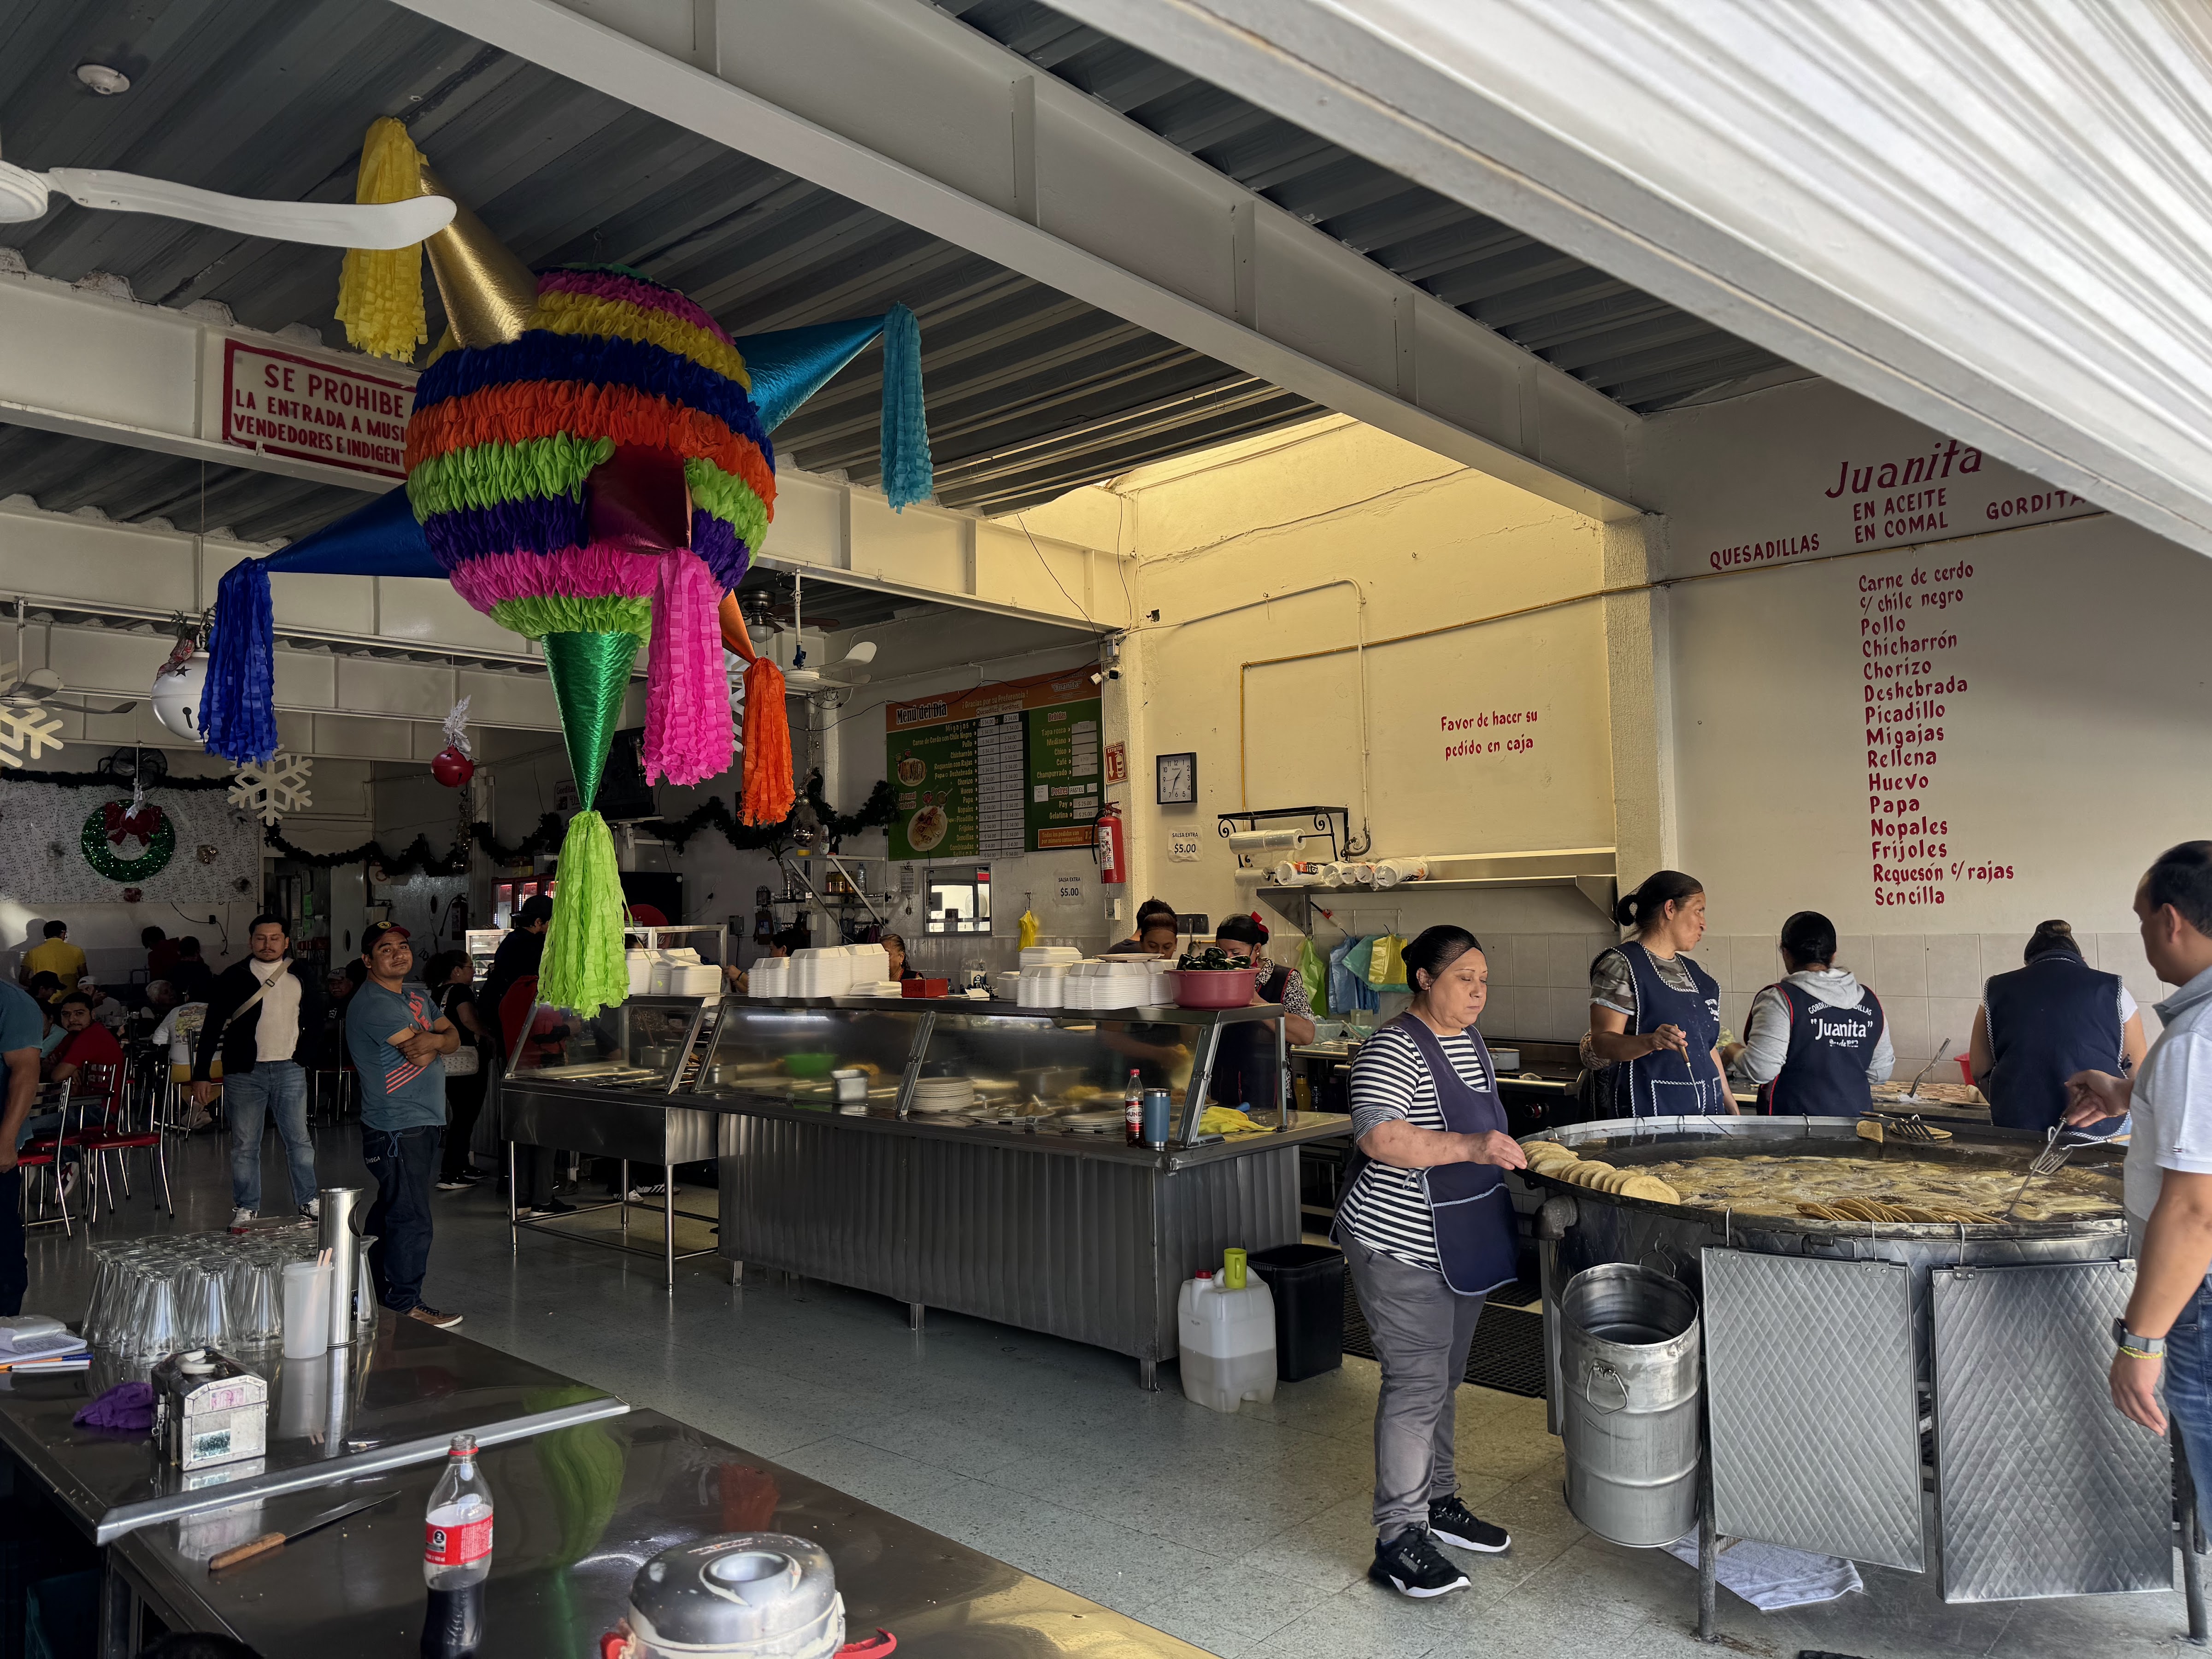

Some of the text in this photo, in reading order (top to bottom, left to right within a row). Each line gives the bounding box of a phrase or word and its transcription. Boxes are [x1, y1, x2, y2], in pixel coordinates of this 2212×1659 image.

[265, 364, 404, 418] SE PROHIBE
[236, 389, 256, 410] LA
[268, 396, 347, 430] ENTRADA
[351, 416, 362, 433] A
[234, 413, 333, 451] VENDEDORES
[337, 436, 343, 453] E
[1824, 439, 1983, 498] Juanita
[1853, 487, 1947, 522] EN ACEITE
[1854, 511, 1949, 544] EN COMAL
[1709, 532, 1820, 571] QUESADILLAS
[1859, 560, 1974, 593] Carne de cerdo
[1860, 589, 1964, 615] c/ chile negro
[1861, 614, 1906, 637] Pollo
[1862, 629, 1957, 658] Chicharrón
[1864, 657, 1931, 681] Chorizo
[965, 699, 982, 709] Gracias
[998, 691, 1025, 703] Preferencia
[1865, 675, 1968, 703] Deshebrada
[897, 700, 947, 724] Menú del Día
[977, 706, 999, 716] Quesadillas
[1441, 711, 1538, 732] Favor de hacer su
[1865, 700, 1945, 725] Picadillo
[1445, 734, 1534, 761] pedido en caja
[1866, 724, 1944, 749] Migajas
[934, 762, 953, 770] Requesón
[951, 750, 972, 759] Chicharrón
[1868, 748, 1937, 768] Rellena
[950, 768, 972, 777] Deshebrada
[1036, 769, 1067, 778] Champurrado
[1869, 773, 1929, 792] Huevo
[1051, 786, 1069, 796] Postres
[1870, 795, 1920, 818] Papa
[1871, 816, 1948, 841] Nopales
[1174, 843, 1196, 854] $5.00
[1872, 839, 1947, 863] Frijoles
[1873, 860, 2014, 887] Requesón c/ rajas
[1060, 887, 1079, 898] $5.00
[1875, 885, 1945, 906] Sencilla
